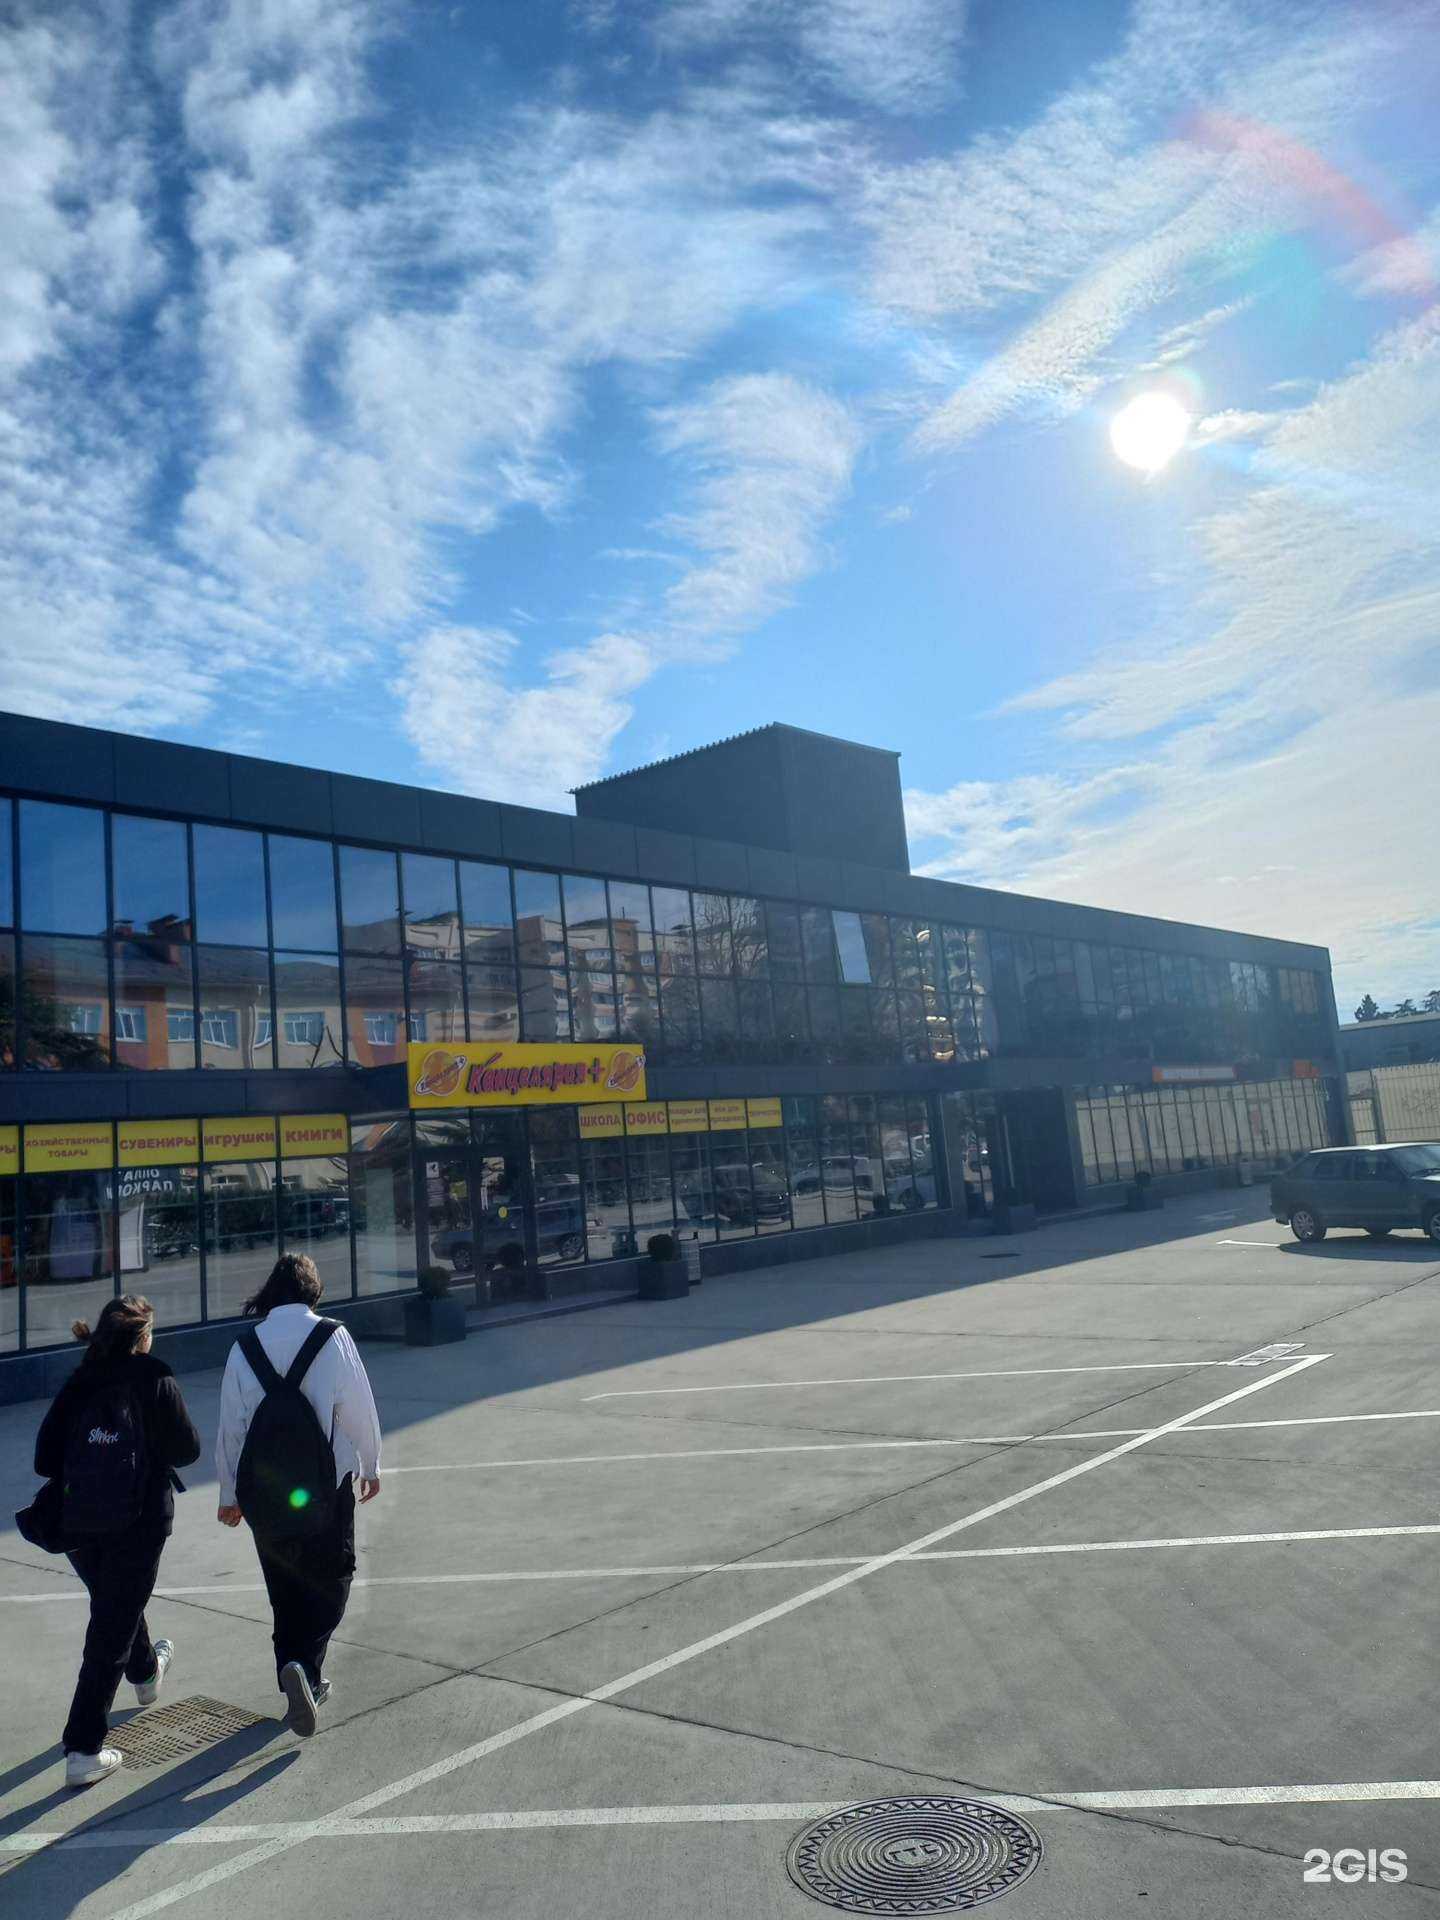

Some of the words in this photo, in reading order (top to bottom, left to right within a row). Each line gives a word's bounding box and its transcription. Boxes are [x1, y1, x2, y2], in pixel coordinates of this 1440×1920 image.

[580, 1114, 622, 1128] ШКОЛА
[627, 1112, 667, 1128] ОФИС
[284, 1128, 343, 1143] КНИГИ
[119, 1136, 197, 1151] СУВЕНИРЫ
